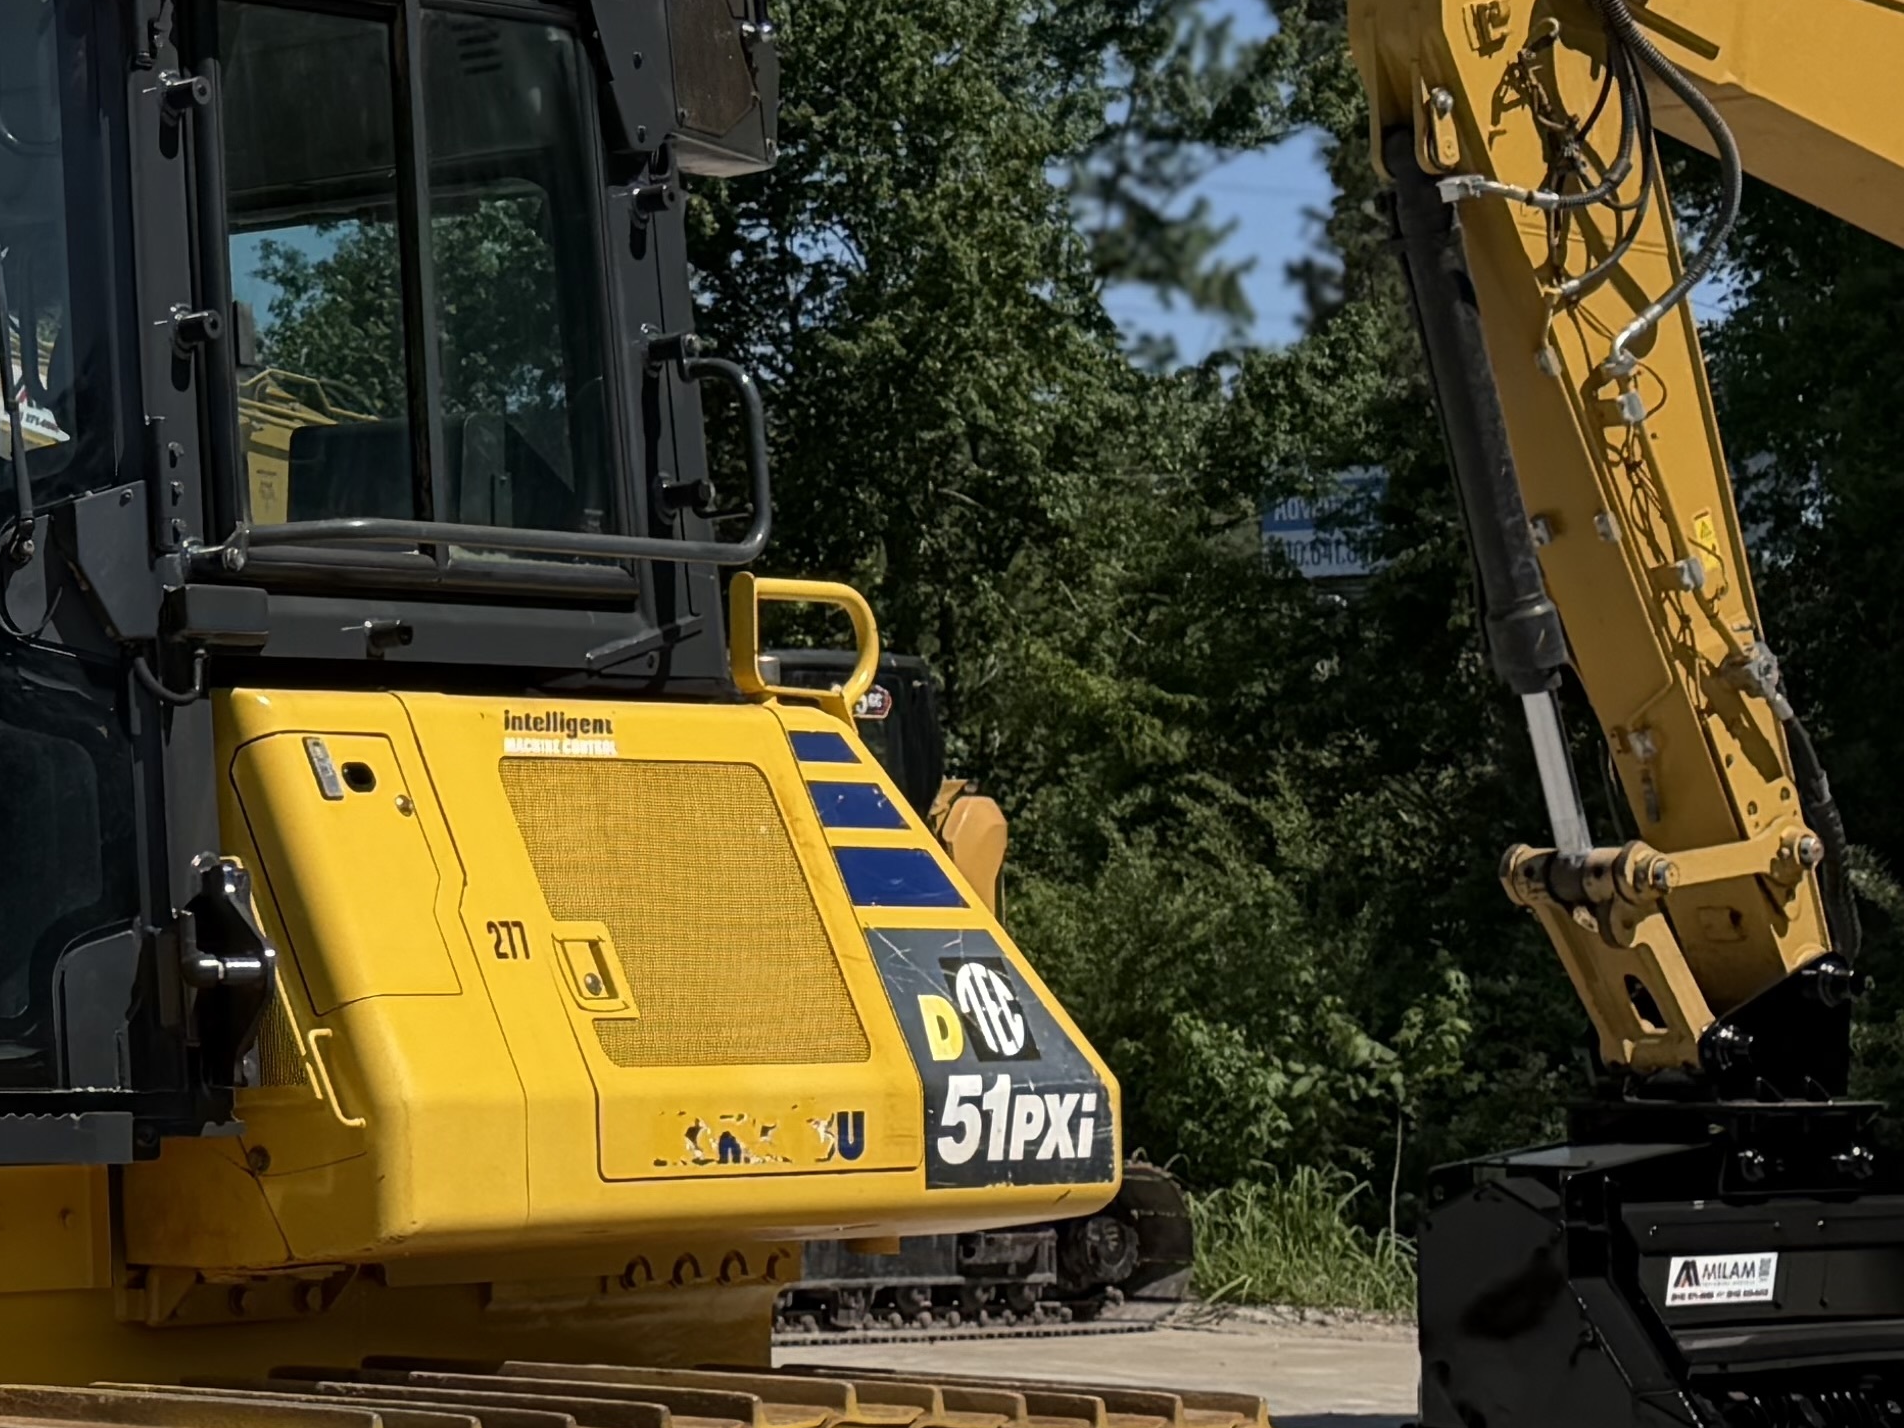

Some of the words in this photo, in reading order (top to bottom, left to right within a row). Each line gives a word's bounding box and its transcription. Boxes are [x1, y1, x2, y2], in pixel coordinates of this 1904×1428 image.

[486, 920, 531, 960] 277
[917, 994, 964, 1061] D
[937, 1074, 1097, 1165] 51PXi
[1702, 1260, 1756, 1281] MILAM
